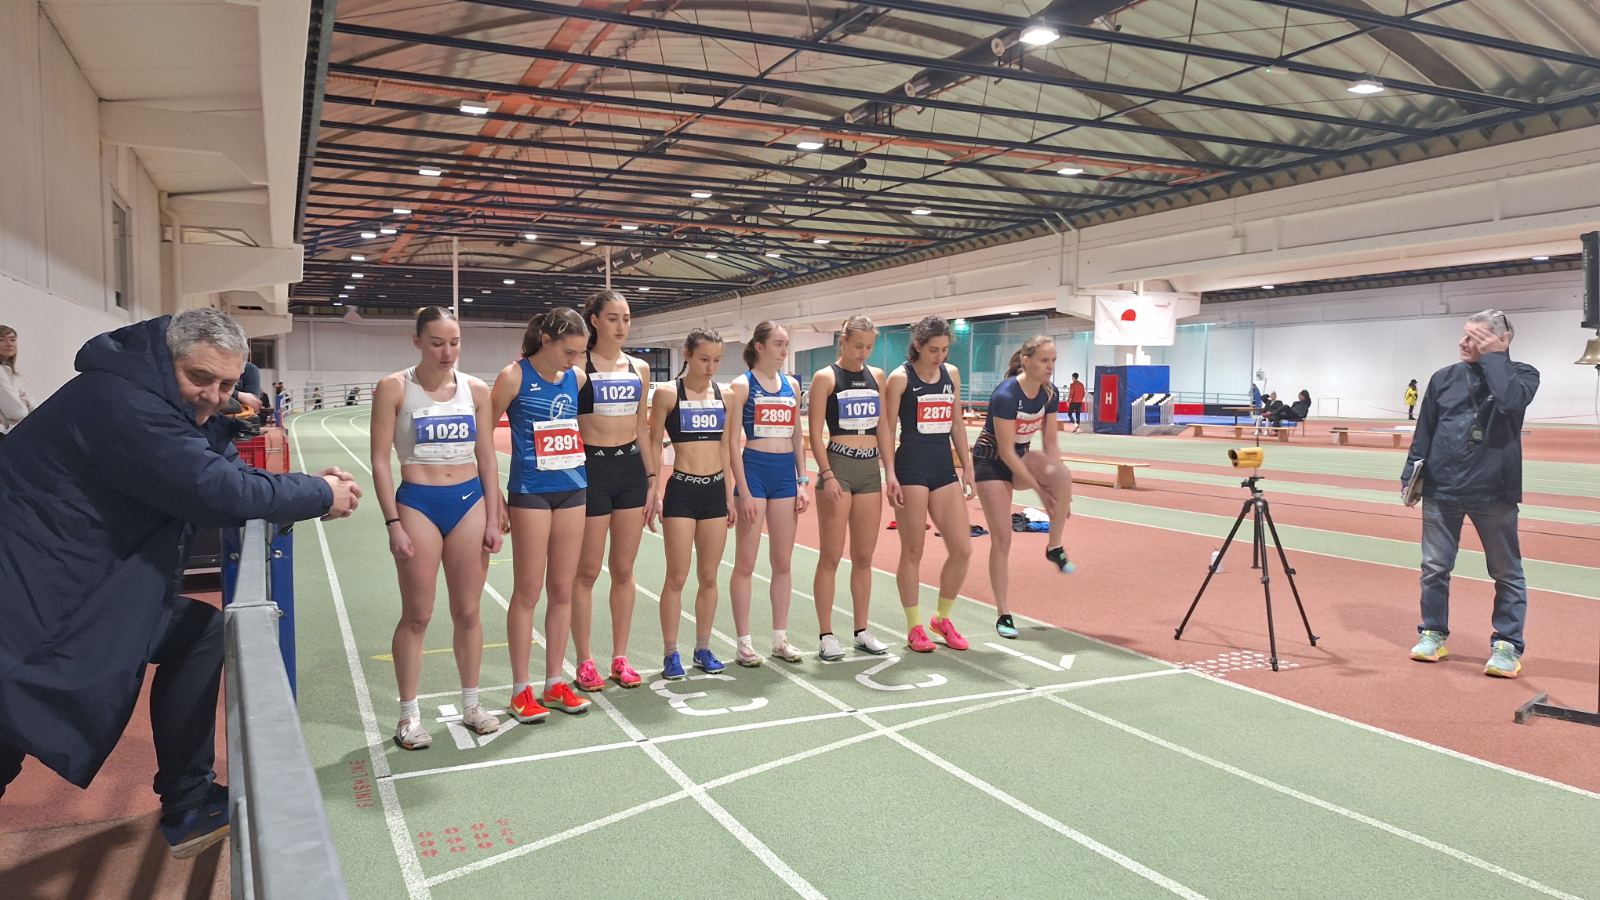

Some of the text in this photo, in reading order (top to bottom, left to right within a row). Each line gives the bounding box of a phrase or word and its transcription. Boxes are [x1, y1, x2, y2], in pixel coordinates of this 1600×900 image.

[601, 385, 635, 400] 1022
[1105, 392, 1112, 404] H
[761, 408, 791, 422] 2890
[846, 402, 876, 416] 1076
[923, 406, 951, 419] 2876
[692, 414, 717, 428] 990
[425, 422, 469, 440] 1028
[543, 434, 578, 452] 2891
[830, 443, 854, 456] NIKE
[855, 448, 874, 458] PRO
[685, 475, 710, 484] PRO
[821, 653, 948, 691] 2
[649, 673, 768, 716] 3
[349, 760, 373, 809] FINISH LINE
